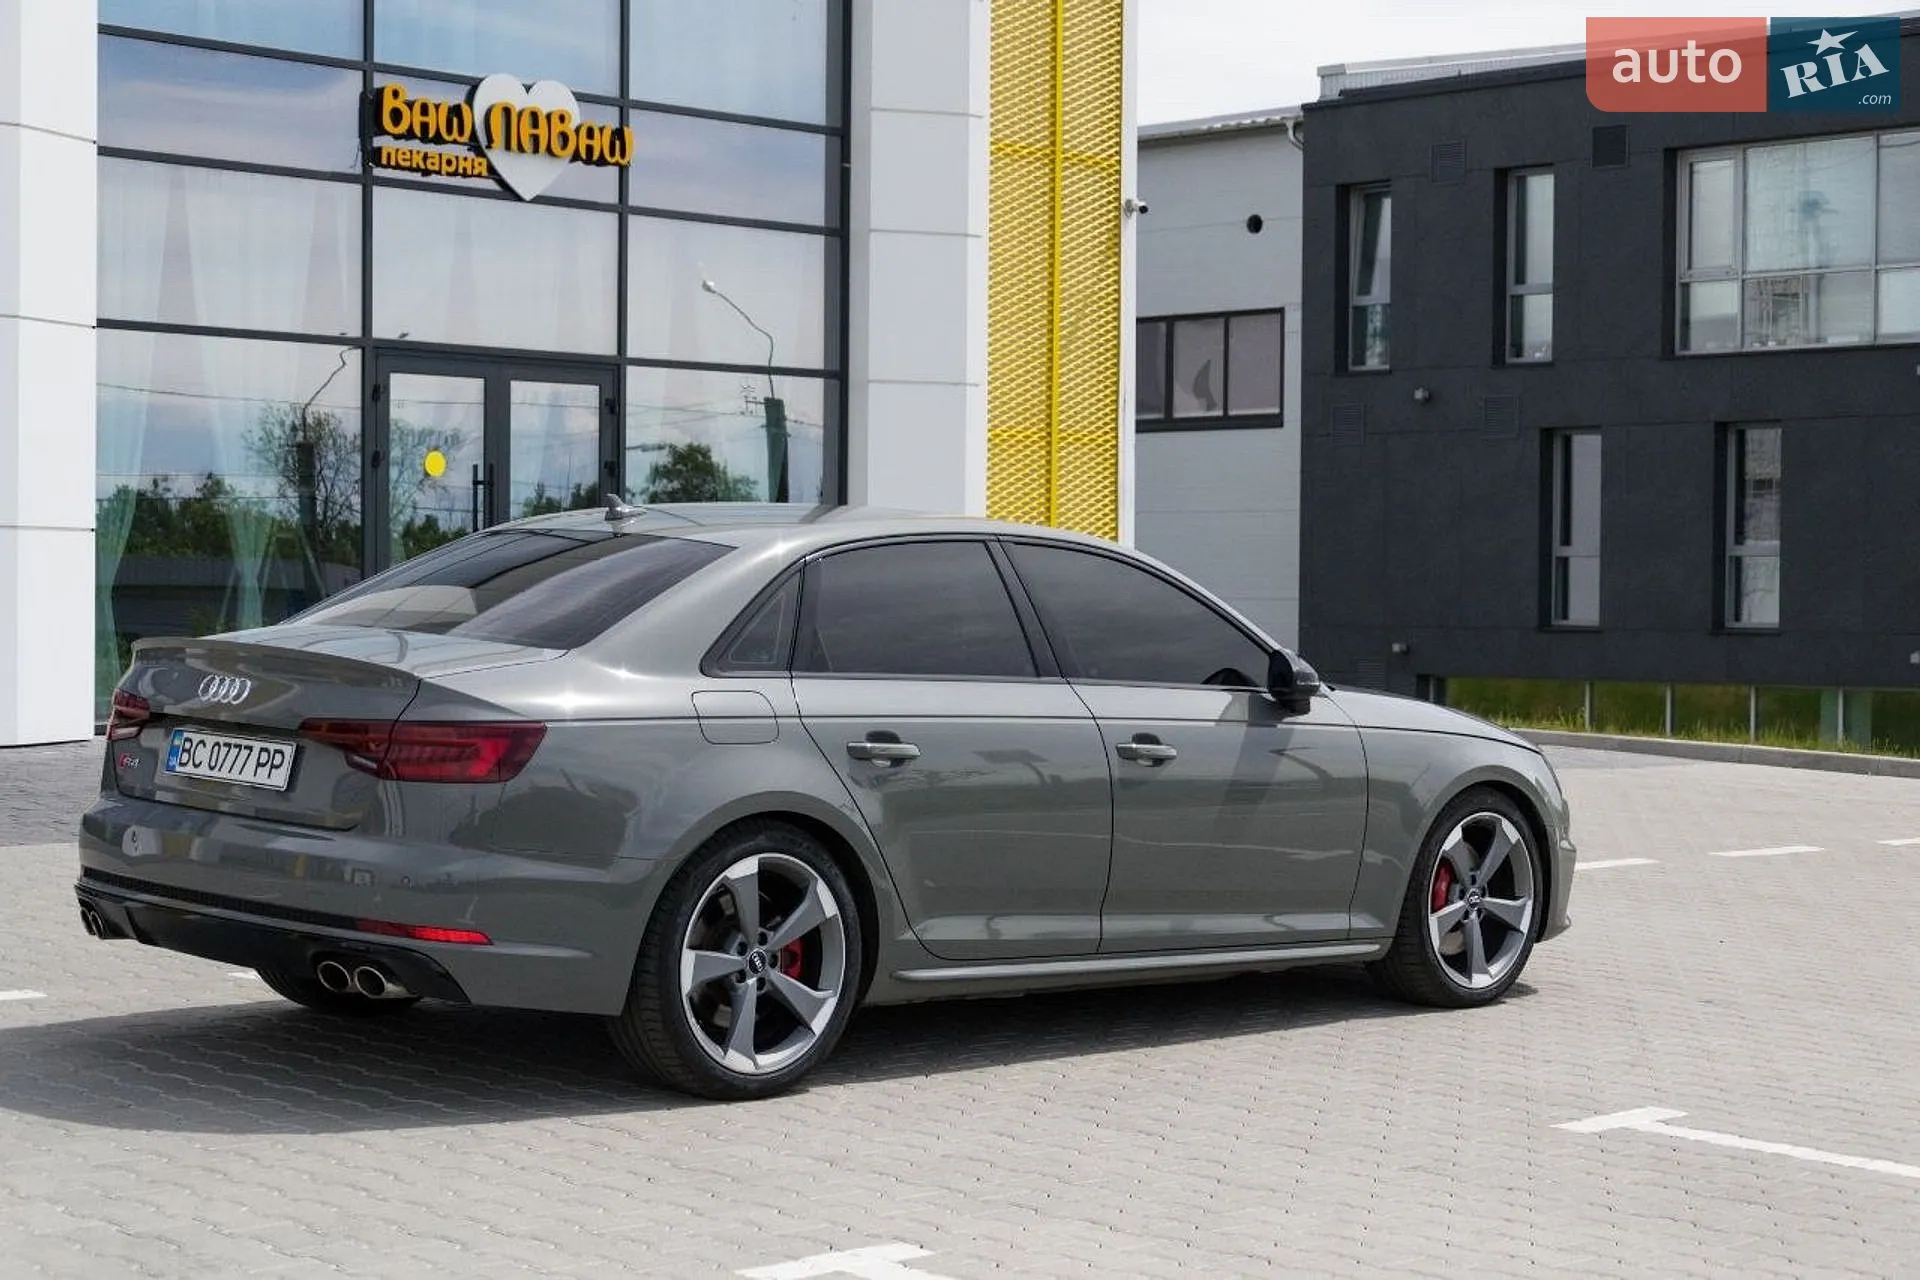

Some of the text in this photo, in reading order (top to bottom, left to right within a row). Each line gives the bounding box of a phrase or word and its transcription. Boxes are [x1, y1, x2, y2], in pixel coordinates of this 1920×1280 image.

[380, 146, 488, 177] пекарня
[178, 737, 285, 779] BC 0777 PP
